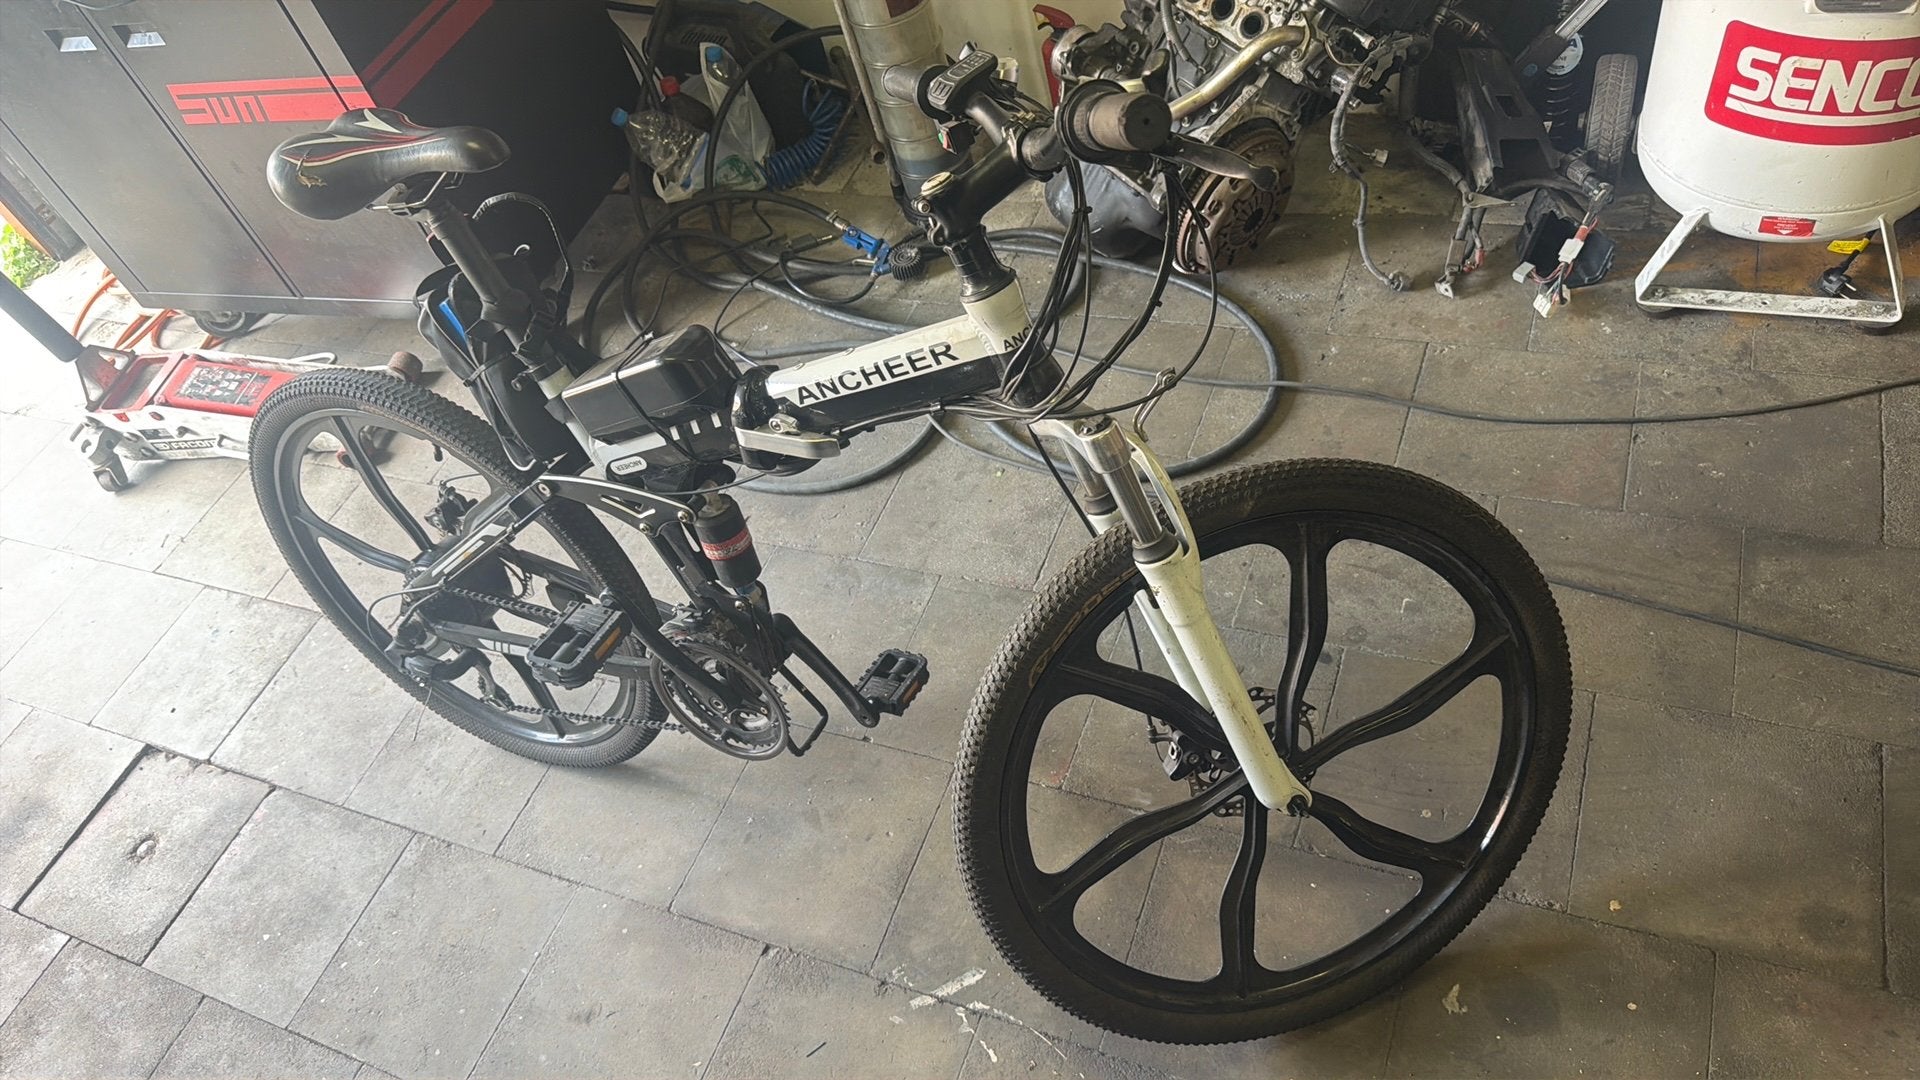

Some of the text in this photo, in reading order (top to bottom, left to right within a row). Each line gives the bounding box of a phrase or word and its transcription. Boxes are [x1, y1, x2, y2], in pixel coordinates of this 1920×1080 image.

[167, 78, 266, 125] SUN
[1003, 324, 1032, 351] ANC
[797, 341, 959, 405] ANCHEER
